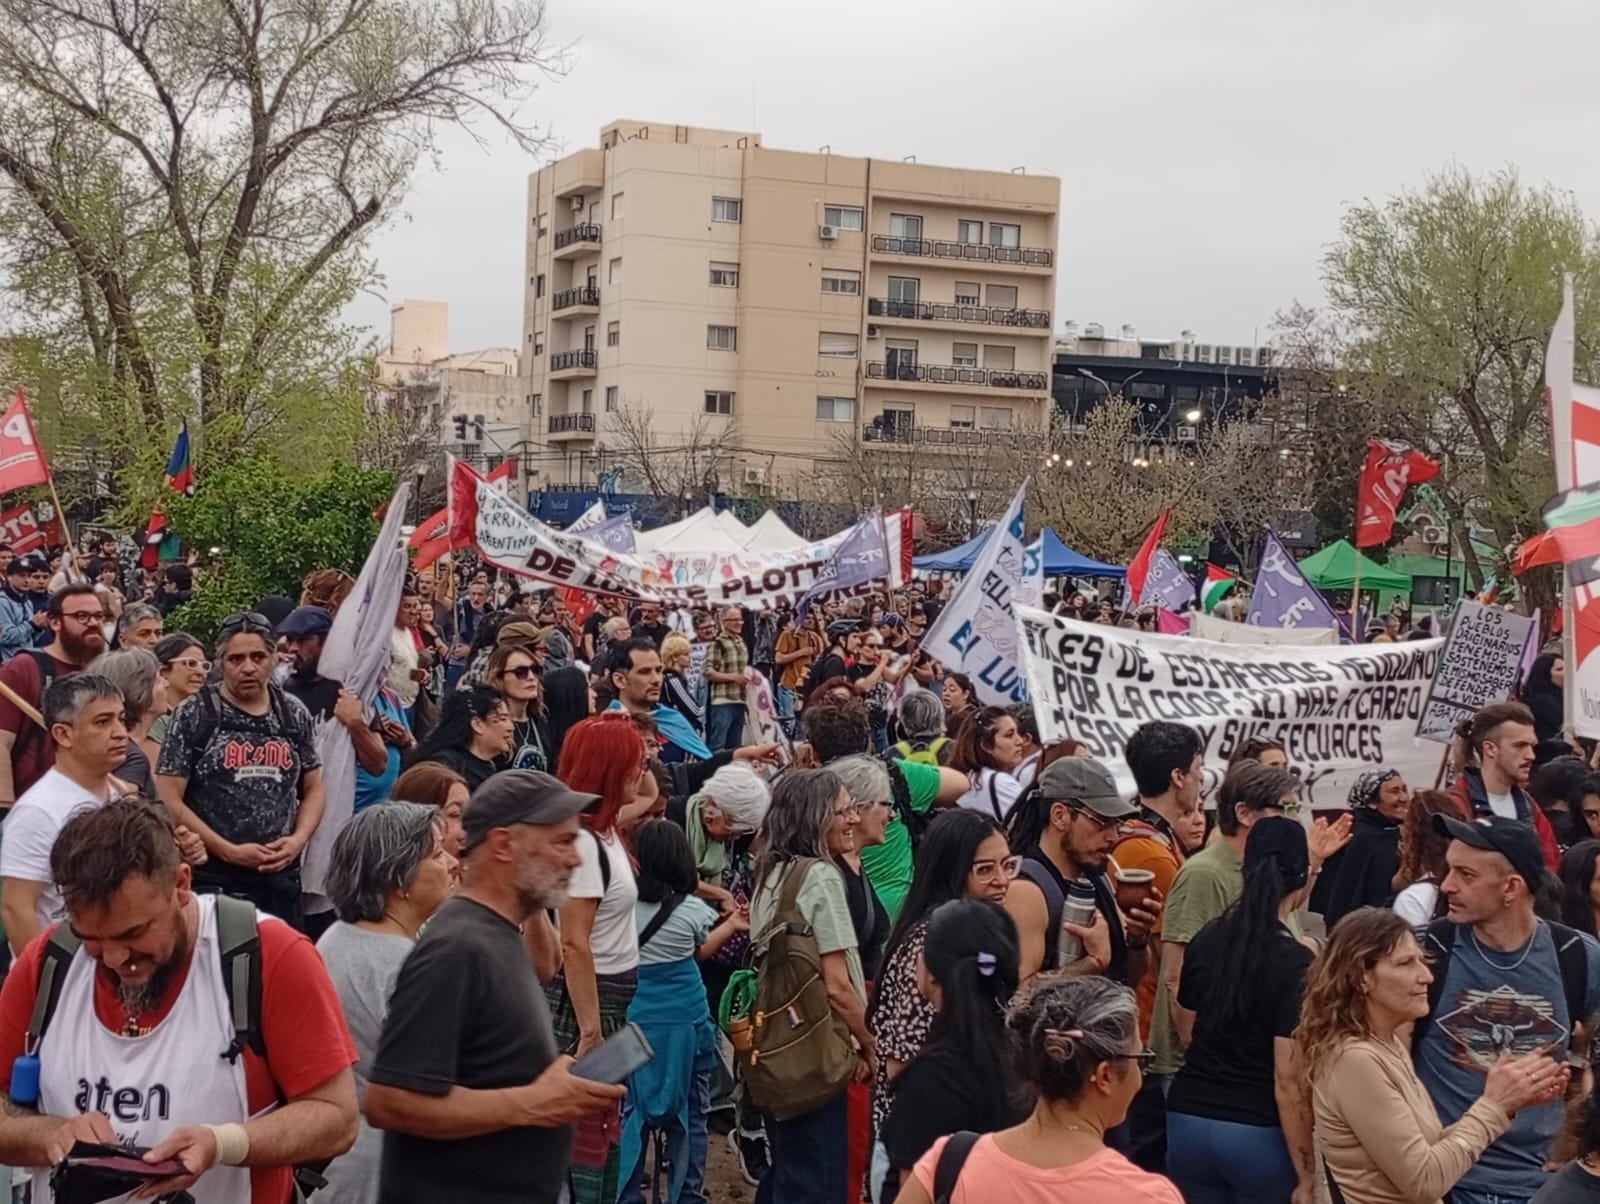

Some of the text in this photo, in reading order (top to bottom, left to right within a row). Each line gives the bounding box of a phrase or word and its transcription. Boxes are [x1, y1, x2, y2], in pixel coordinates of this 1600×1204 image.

[525, 548, 577, 580] DE
[722, 560, 830, 599] PLOTT
[1460, 616, 1510, 640] PUEBLOS
[1477, 608, 1502, 624] LOS
[1451, 641, 1507, 664] TENEMOS
[1456, 627, 1521, 655] ORIGINARIOS
[1116, 641, 1154, 682] DE
[1160, 651, 1334, 689] ESTAFADOS
[1446, 652, 1514, 678] SOSTENEMOS
[1053, 665, 1105, 714] POR
[1107, 683, 1143, 719] LA
[1355, 686, 1421, 720] CARGO
[1439, 675, 1497, 699] DEFENDER
[1462, 693, 1485, 705] VIDA
[75, 1076, 170, 1121] aten
